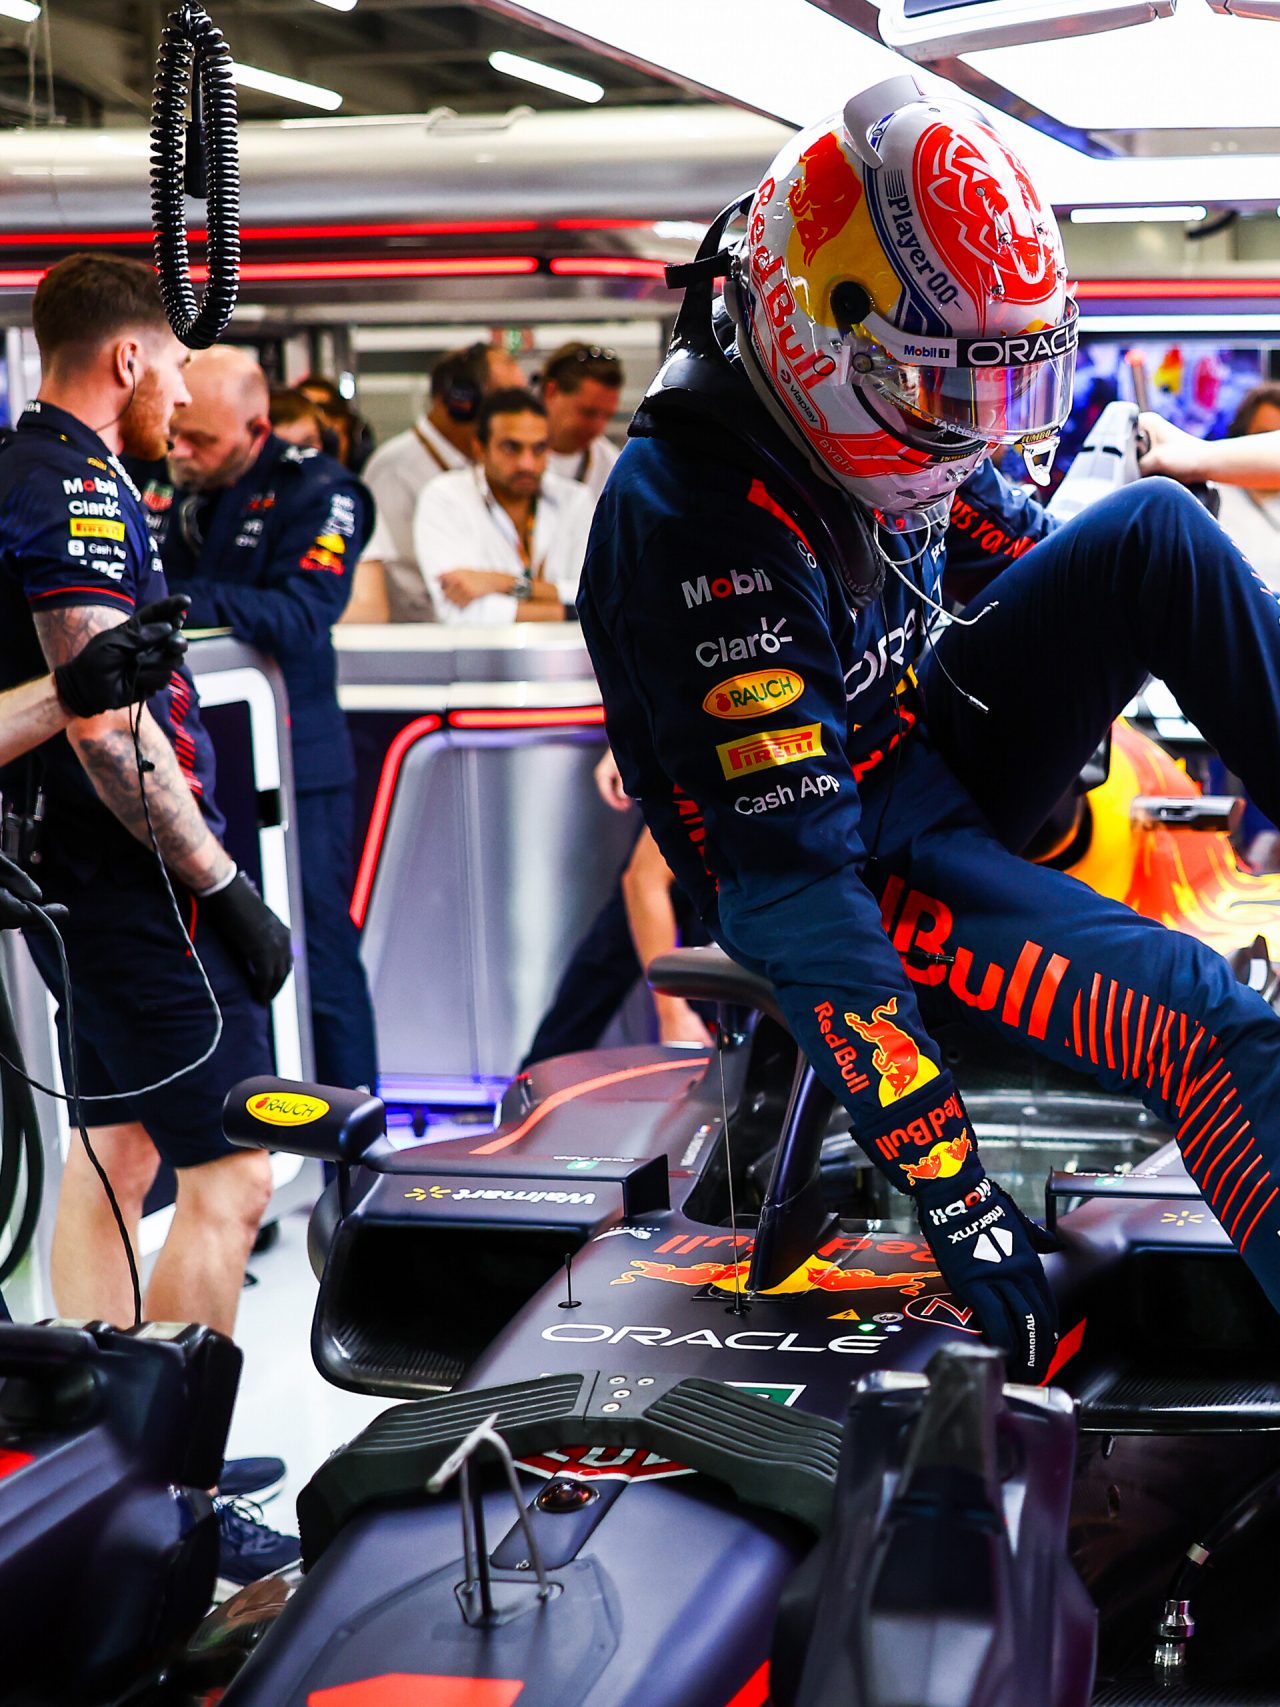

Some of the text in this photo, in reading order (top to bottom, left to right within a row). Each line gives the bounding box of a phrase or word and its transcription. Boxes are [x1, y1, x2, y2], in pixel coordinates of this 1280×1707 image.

[888, 195, 936, 275] Player
[766, 279, 837, 390] Bull
[904, 344, 937, 359] Mobil
[790, 385, 818, 424] viaplay
[819, 438, 855, 472] BYBIT
[62, 476, 119, 498] Mobil
[68, 500, 118, 518] Claro
[681, 568, 773, 609] Mobil
[695, 629, 785, 668] Claro
[730, 677, 795, 709] RAUCH
[728, 731, 813, 771] PIRELLI
[734, 774, 841, 816] Cash App
[893, 889, 1071, 1041] Bull
[814, 1000, 871, 1095] Red Bull
[264, 1099, 318, 1118] RAUCH
[875, 1115, 930, 1162] Bull
[451, 1188, 597, 1205] Walmart
[929, 1178, 993, 1227] Mobil
[653, 1234, 756, 1255] ull
[541, 1322, 890, 1355] ORACLE
